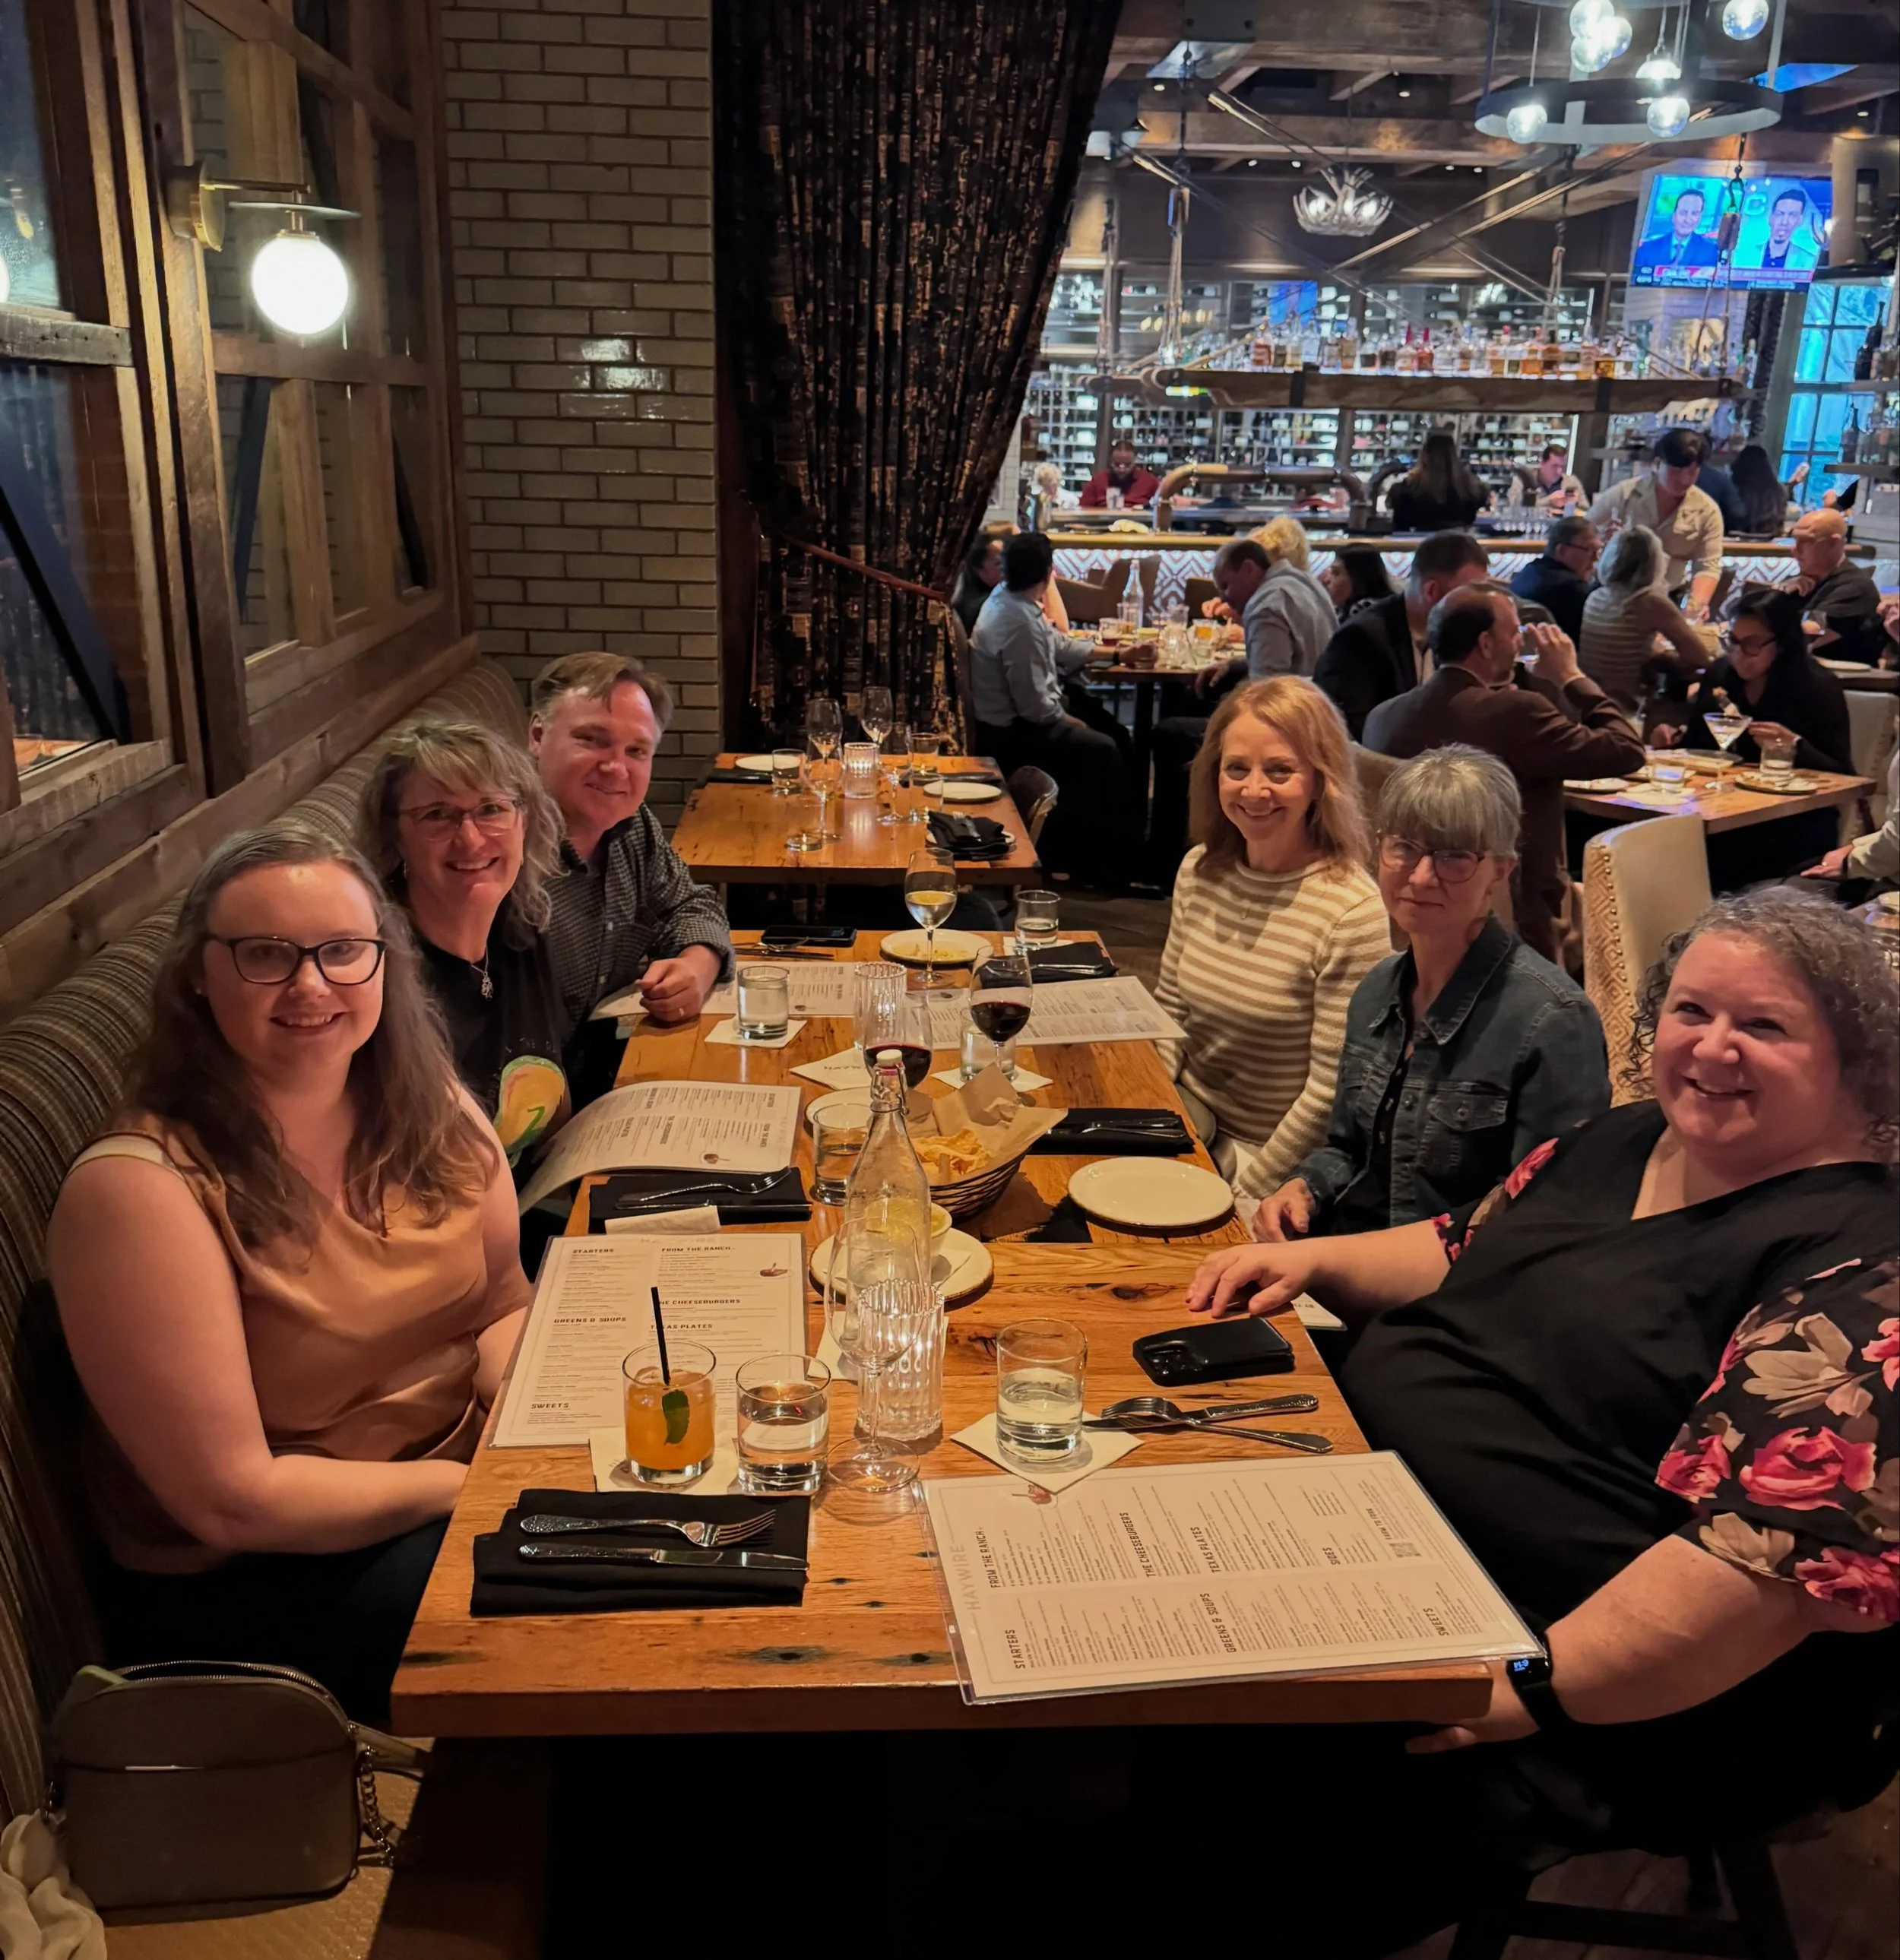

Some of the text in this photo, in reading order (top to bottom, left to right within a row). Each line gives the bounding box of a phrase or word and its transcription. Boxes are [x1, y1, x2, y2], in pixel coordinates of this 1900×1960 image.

[974, 1530, 1001, 1588] FROM THE RANCH
[1118, 1512, 1156, 1577] THE CHEESEBURGERS
[1189, 1526, 1221, 1572] TEXAS PLATES
[1321, 1547, 1341, 1565] SIDES
[949, 1544, 980, 1610] HAYWIRE
[1199, 1592, 1218, 1615] SOUPS
[1421, 1607, 1449, 1635] SWEETS
[1004, 1629, 1026, 1669] STARTERS
[1214, 1624, 1237, 1652] GREENS
